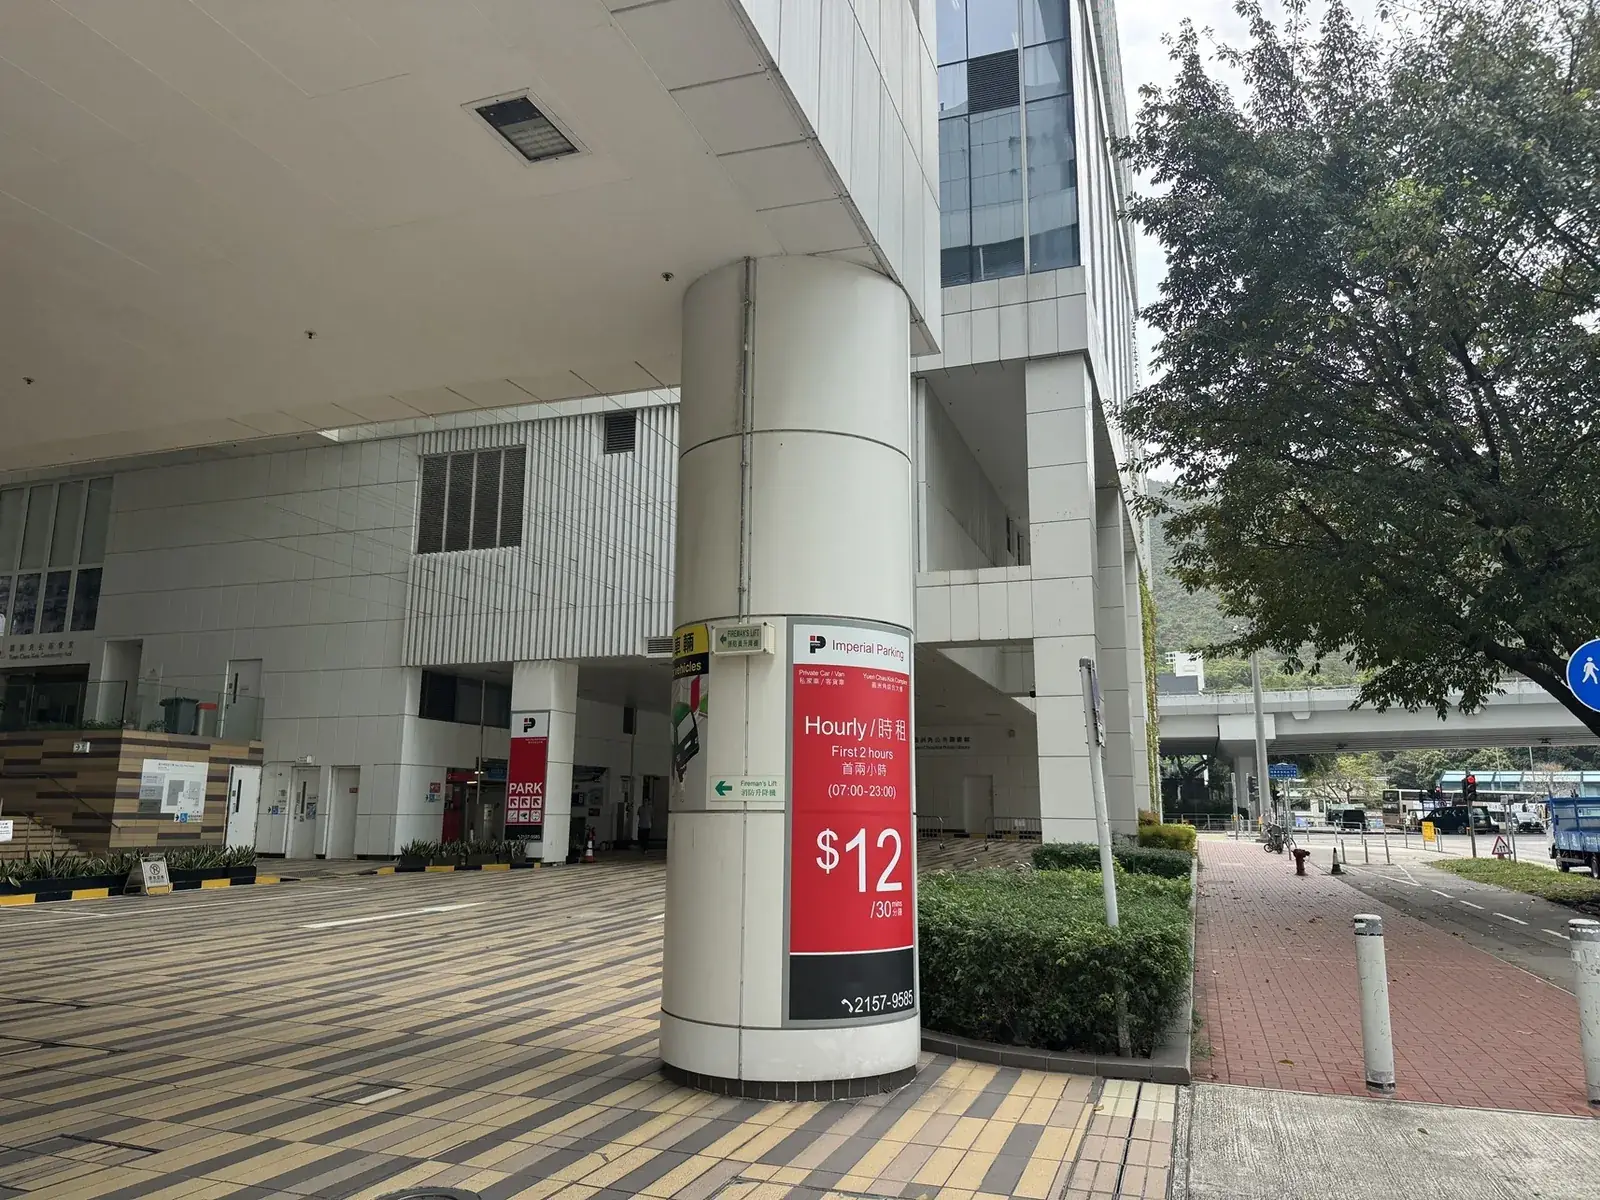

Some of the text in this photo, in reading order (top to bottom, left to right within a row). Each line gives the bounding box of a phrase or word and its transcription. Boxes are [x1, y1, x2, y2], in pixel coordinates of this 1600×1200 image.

[728, 628, 760, 638] FIREMAN'S LIFT
[832, 639, 905, 662] Imperial Parking
[798, 669, 819, 677] Private
[820, 669, 830, 677] Car
[862, 672, 876, 681] Yuen
[805, 715, 867, 742] Hourly
[878, 717, 907, 741] 時租
[831, 745, 894, 760] First 2 hours
[842, 761, 887, 777] 首兩小時
[509, 782, 543, 795] PARK
[741, 779, 767, 787] Fireman's
[828, 783, 897, 800] (07:00-23:00)
[870, 900, 892, 919] /30
[854, 988, 914, 1014] 2157-9585
